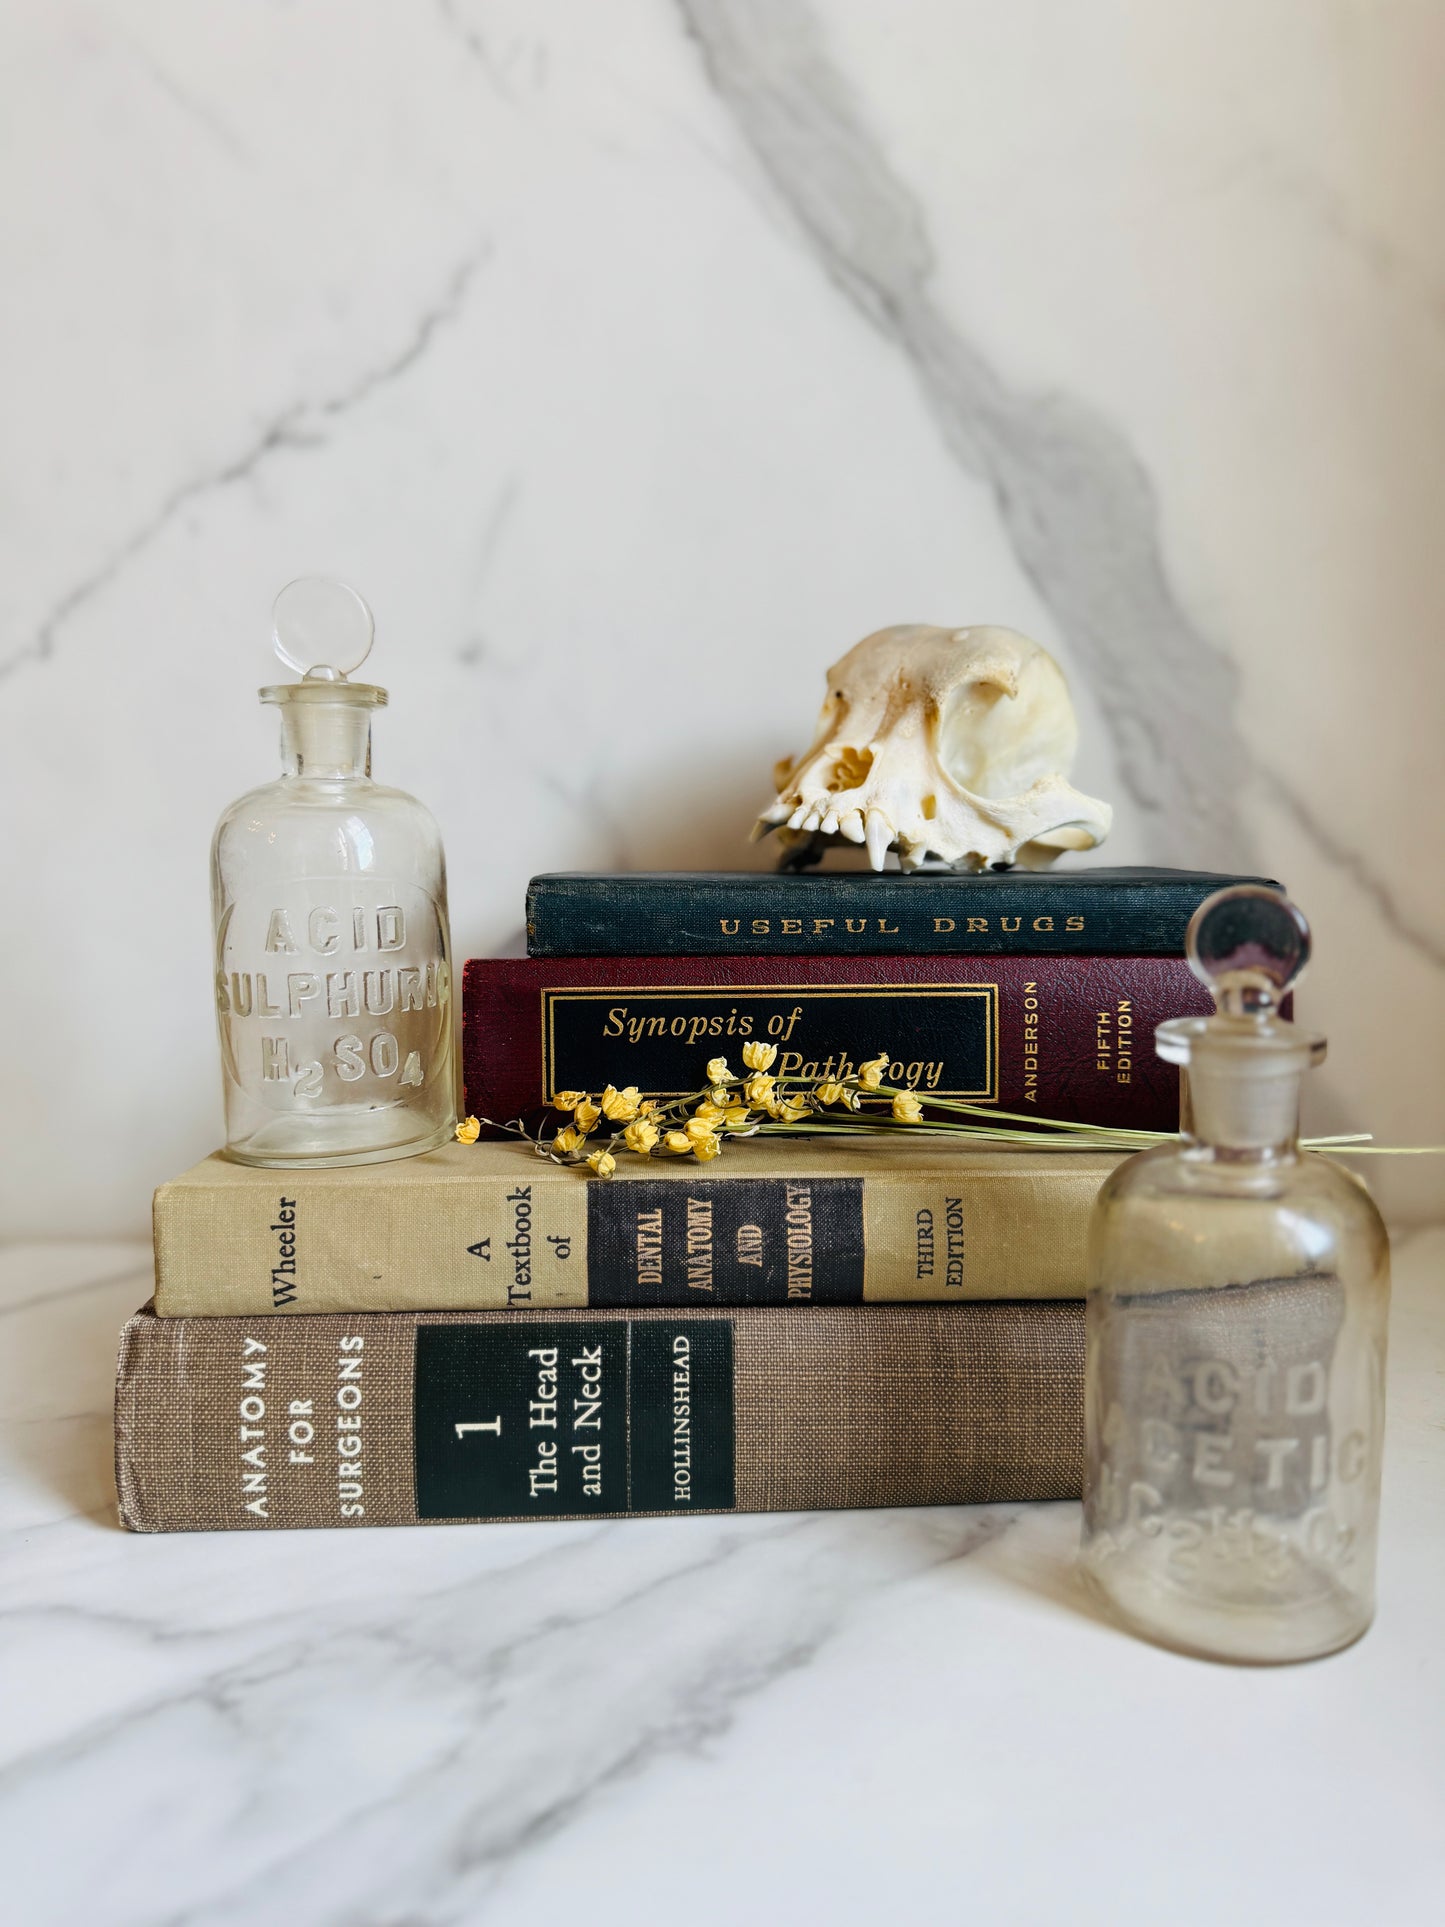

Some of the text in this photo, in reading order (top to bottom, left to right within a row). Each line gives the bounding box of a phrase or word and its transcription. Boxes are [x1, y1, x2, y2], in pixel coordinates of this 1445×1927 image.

[264, 905, 407, 957] ACID
[720, 916, 1086, 935] USEFUL DRUGS
[216, 958, 450, 1019] SULPHURIC
[603, 1006, 802, 1044] Synopsis of
[778, 1052, 944, 1088] Pathogy
[1024, 981, 1038, 1103] ANDERSON
[1097, 1012, 1111, 1070] FIFTH
[1117, 1000, 1132, 1084] EDITION
[270, 1197, 298, 1308] Wheeler
[467, 1237, 490, 1262] A
[507, 1185, 531, 1306] Textbook
[546, 1235, 571, 1260] of
[637, 1208, 662, 1285] DENTAL
[687, 1197, 713, 1292] ANATOMY
[737, 1224, 763, 1268] AND
[786, 1185, 812, 1299] PHYSIOLOGY
[917, 1208, 934, 1279] THIRD
[945, 1197, 964, 1287] EDITION
[240, 1337, 269, 1518] ANATOMY
[288, 1399, 315, 1463] FOR
[337, 1336, 365, 1517] SURGEONS
[455, 1415, 501, 1439] 1
[529, 1347, 558, 1497] The Head
[572, 1345, 602, 1496] and Neck
[673, 1335, 691, 1500] HOLLINSHEAD
